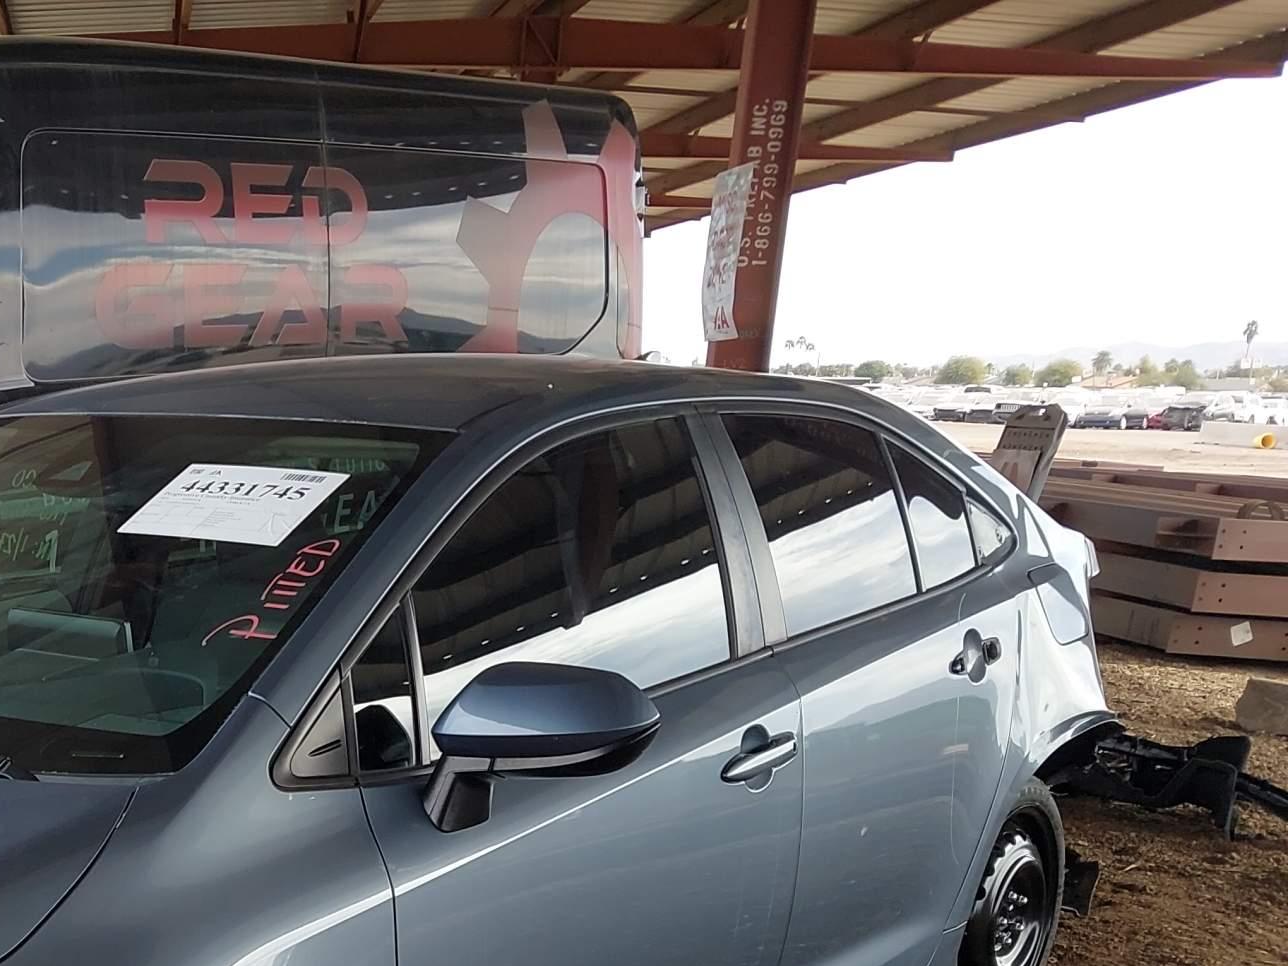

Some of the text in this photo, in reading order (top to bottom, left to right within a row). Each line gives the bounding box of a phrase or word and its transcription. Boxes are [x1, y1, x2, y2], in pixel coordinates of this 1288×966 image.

[750, 98, 770, 136] INC.
[143, 159, 368, 247] RED
[752, 100, 788, 266] 1-866-799-0969
[95, 264, 409, 349] GEAR
[180, 479, 310, 501] 44331745
